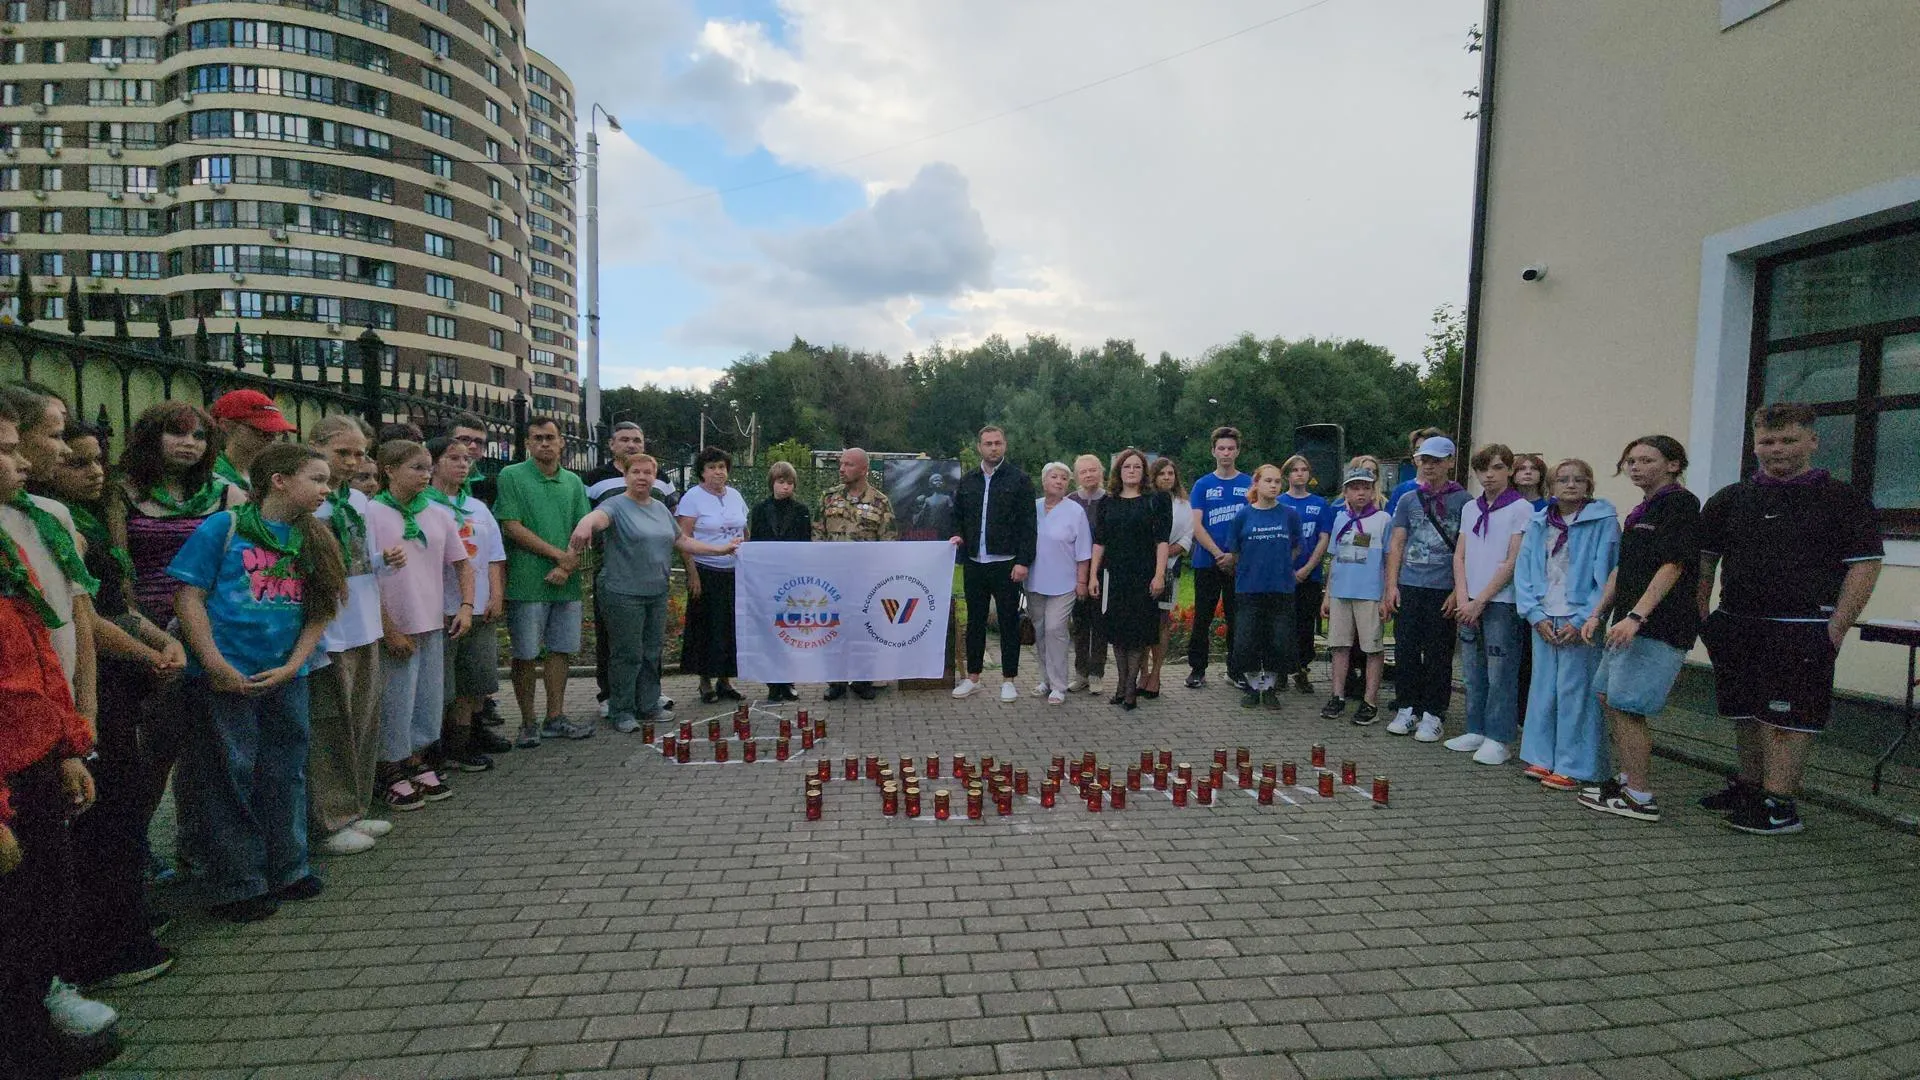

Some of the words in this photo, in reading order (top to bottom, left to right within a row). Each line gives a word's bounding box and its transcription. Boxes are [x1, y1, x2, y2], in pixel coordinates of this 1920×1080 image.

[773, 575, 842, 602] АССОЦИАЦИЯ
[862, 575, 894, 614] Ассоциация
[895, 574, 930, 595] ветеранов
[927, 594, 936, 611] СВО
[783, 609, 832, 627] СВО
[778, 630, 838, 649] ВЕТЕРАНОВ
[864, 621, 907, 648] Московской
[907, 619, 933, 645] области
